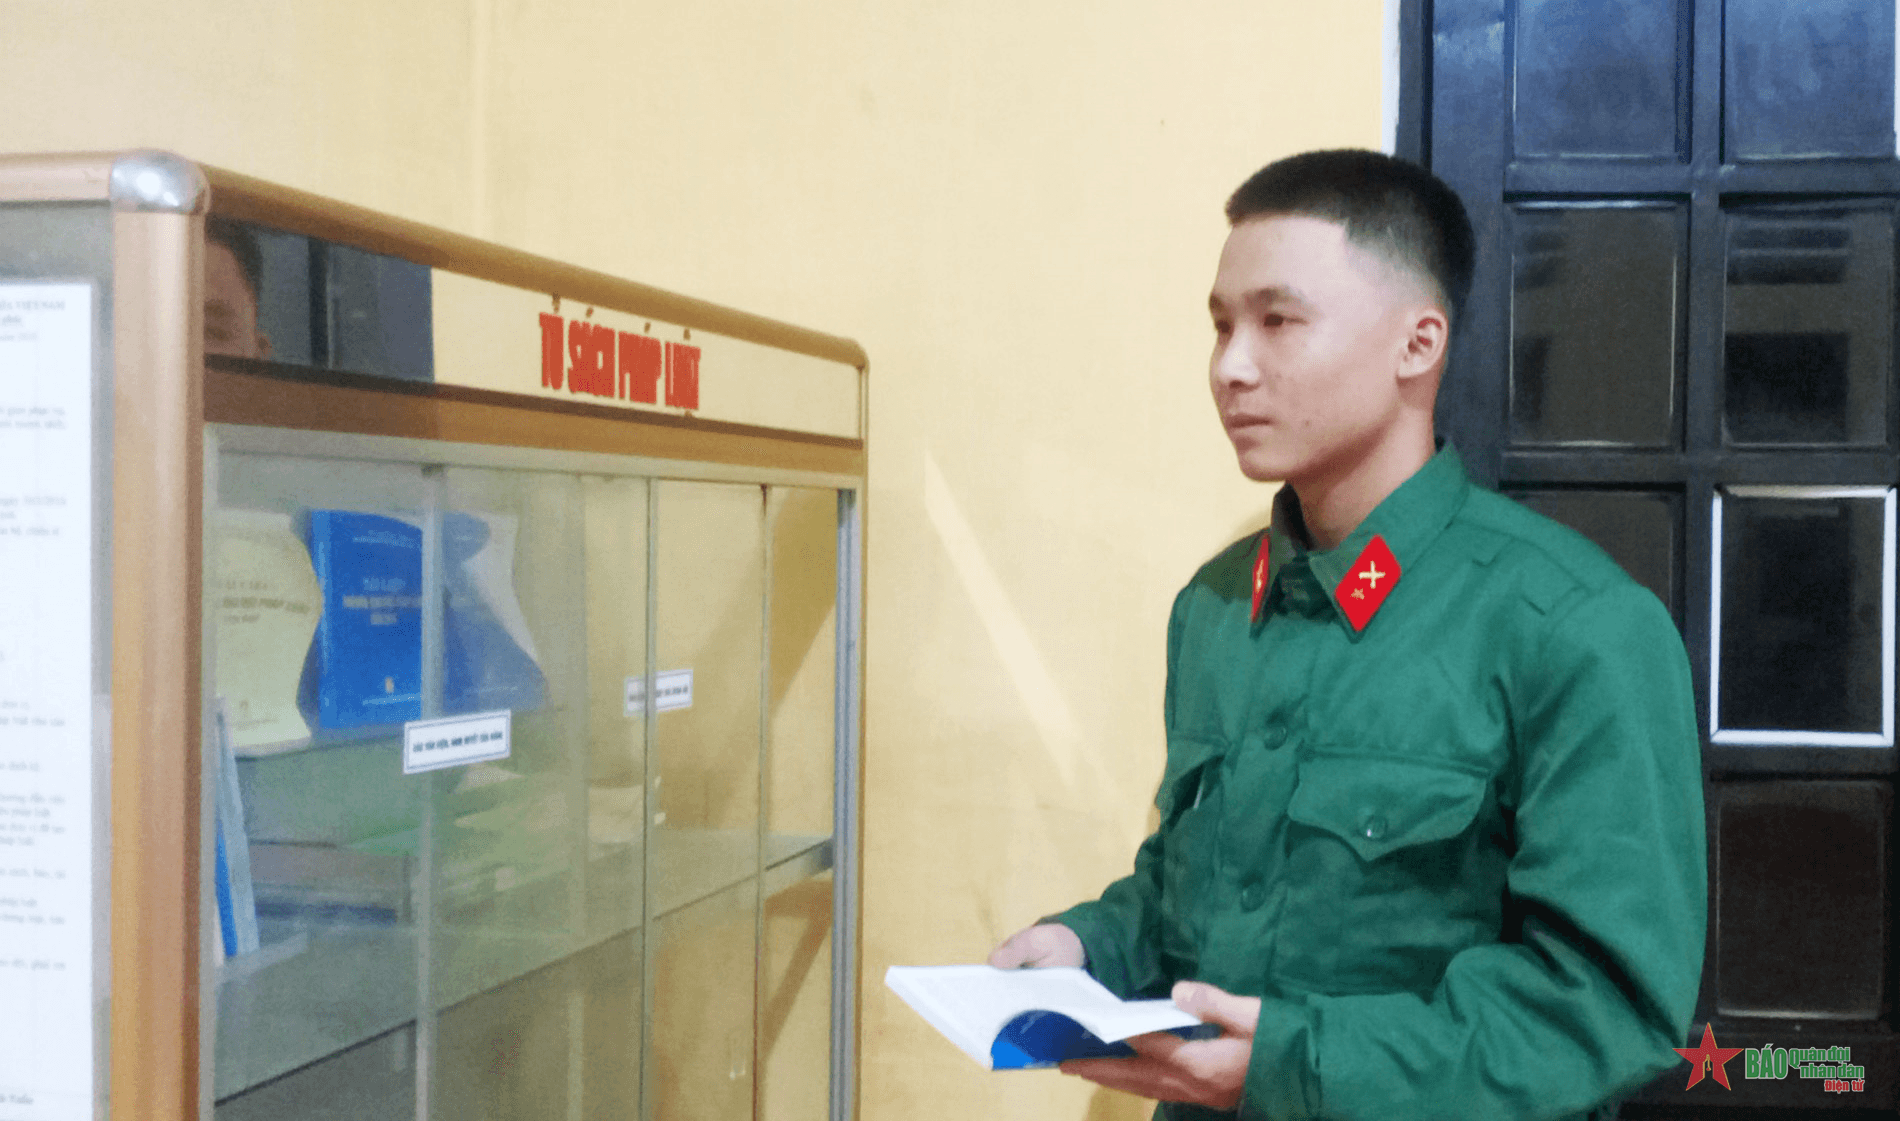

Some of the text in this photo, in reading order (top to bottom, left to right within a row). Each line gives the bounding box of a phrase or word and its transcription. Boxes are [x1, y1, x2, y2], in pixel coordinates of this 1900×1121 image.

[567, 306, 616, 399] SÁCH
[618, 322, 663, 405] PHÁP
[664, 328, 702, 418] LUẬT
